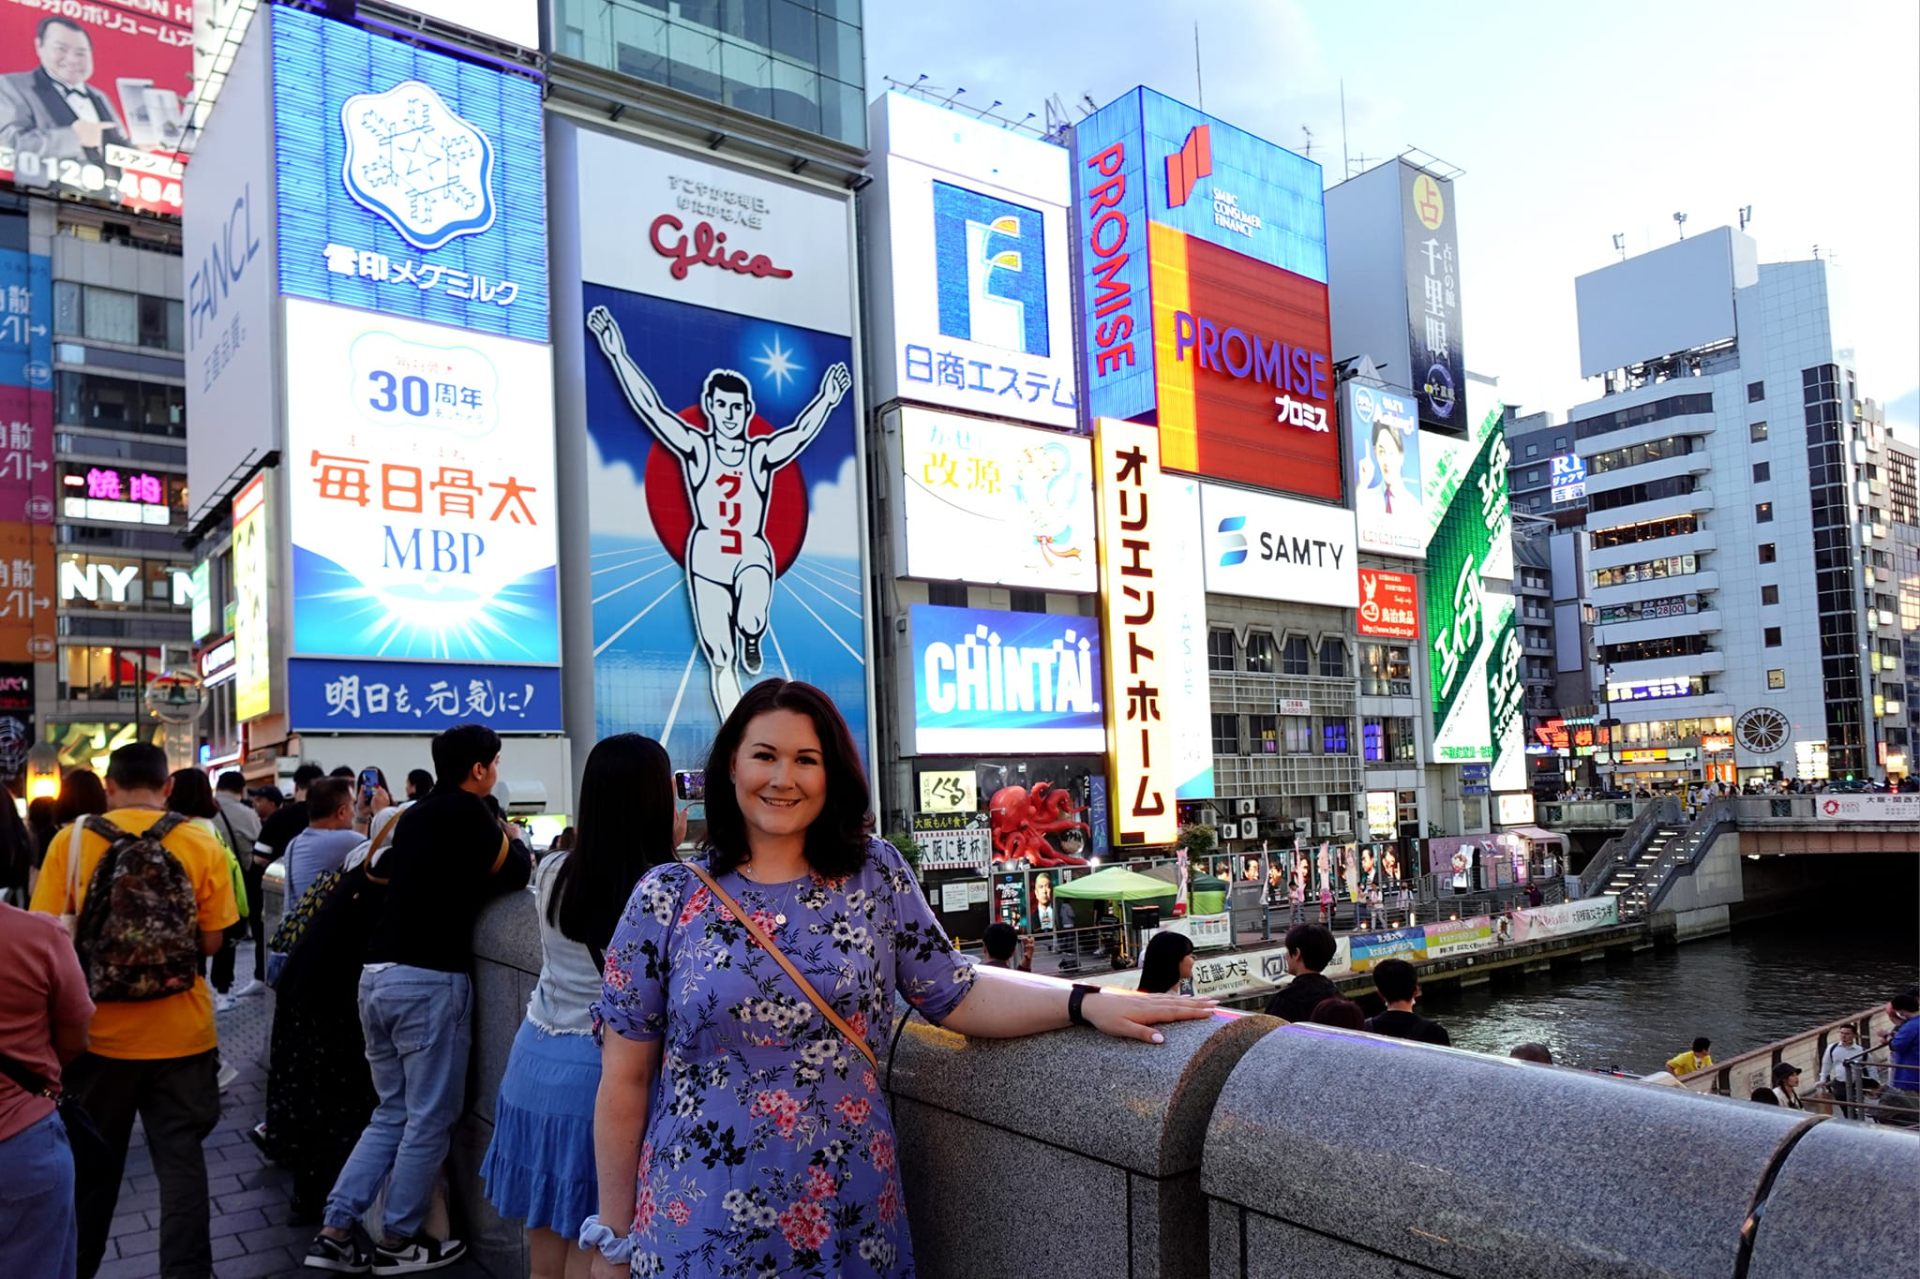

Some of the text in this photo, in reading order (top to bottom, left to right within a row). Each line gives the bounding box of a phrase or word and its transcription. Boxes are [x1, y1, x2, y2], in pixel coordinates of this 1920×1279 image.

[189, 182, 259, 352] FANCL
[649, 214, 793, 280] Glico
[1087, 142, 1136, 378] PROMISE
[1420, 238, 1449, 358] 千里眼
[905, 344, 1078, 410] 日商エステム
[1174, 310, 1328, 400] PROMISE
[369, 370, 483, 417] 30周年
[1275, 394, 1330, 433] プロミス
[310, 449, 538, 526] 毎日骨太
[715, 471, 743, 555] グリコ
[61, 562, 138, 602] NY
[383, 525, 485, 575] MBP
[1260, 532, 1344, 570] SAMTY
[1116, 446, 1166, 817] オリエントホーム
[1434, 553, 1486, 699] エイブル
[931, 777, 965, 806] くくる
[918, 837, 981, 864] 大阪に乾杯
